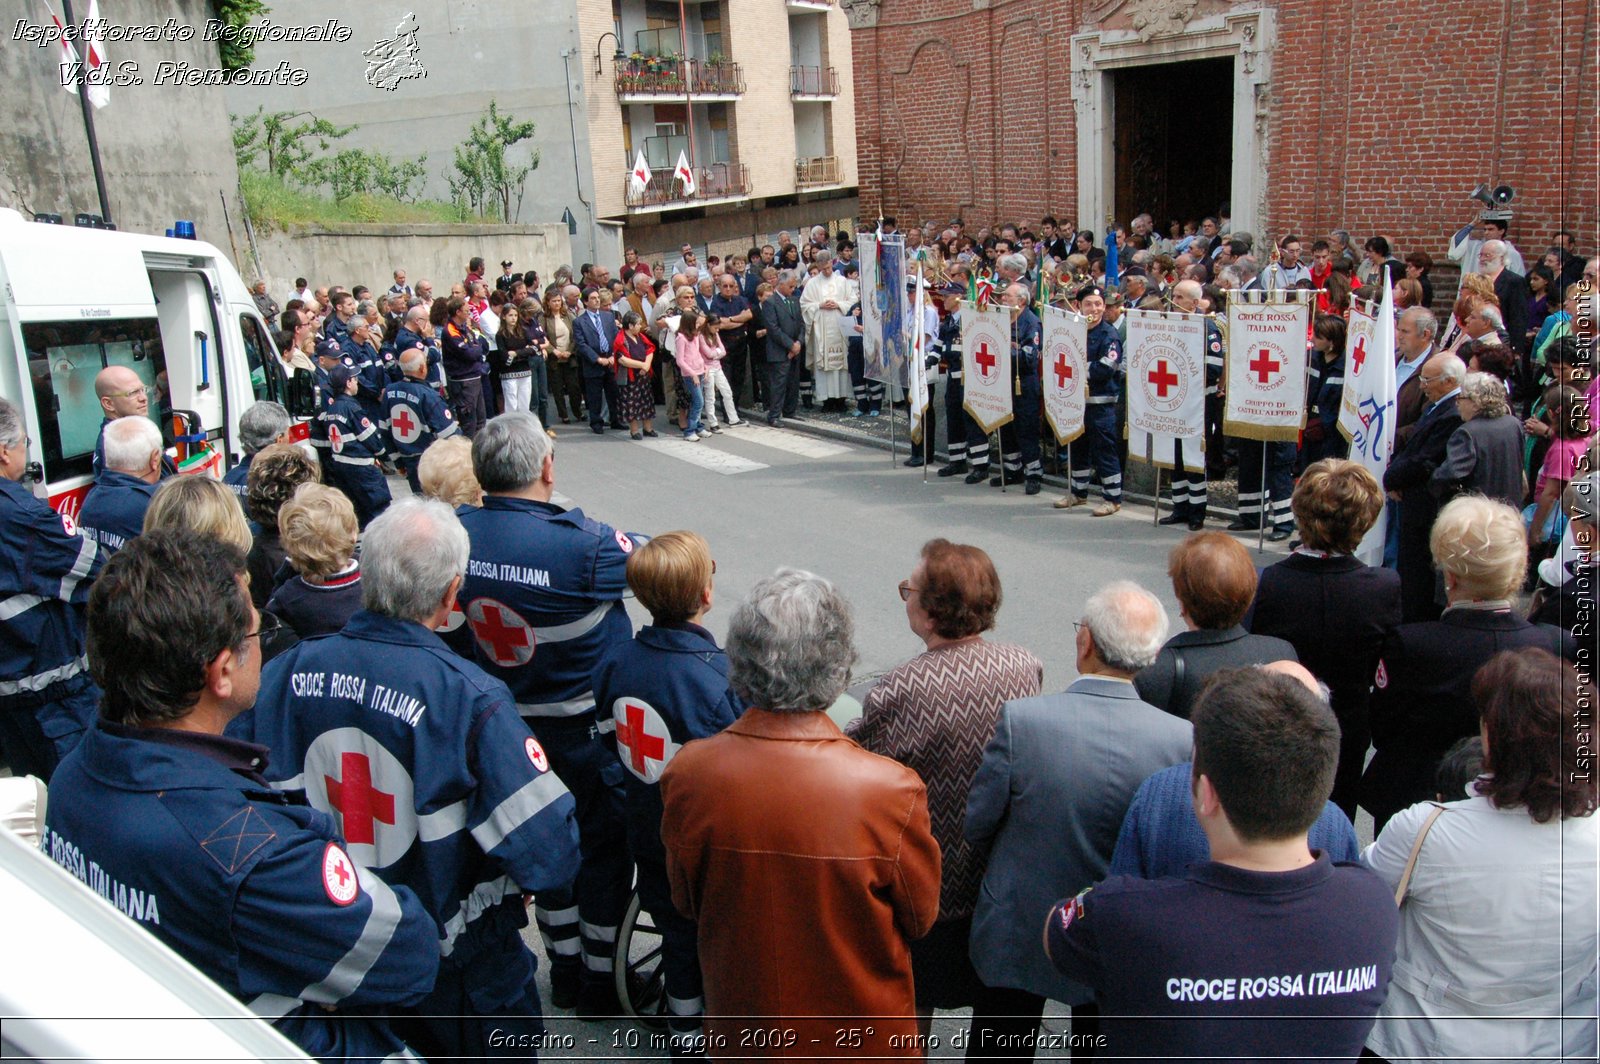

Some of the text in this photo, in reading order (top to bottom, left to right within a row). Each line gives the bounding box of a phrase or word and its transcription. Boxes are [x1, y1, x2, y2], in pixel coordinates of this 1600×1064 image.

[1237, 313, 1298, 322] CROCE ROSSA
[1246, 324, 1287, 333] ITALIANA
[1144, 333, 1173, 343] ROSSA
[1172, 336, 1200, 378] ITALIANA
[1258, 340, 1289, 366] VOLONTARI
[1063, 400, 1082, 412] LOCALE
[1245, 399, 1286, 408] GRUPPO DI
[1135, 418, 1196, 436] CASALBORGONE
[1178, 418, 1186, 426] DI
[99, 530, 125, 550] ITALIANA
[469, 559, 498, 580] ROSSA
[499, 564, 550, 587] ITALIANA
[291, 672, 427, 728] CROCE ROSSA ITALIANA
[51, 830, 88, 886] ROSSA
[89, 861, 160, 925] ITALIANA
[1166, 964, 1377, 1001] CROCE ROSSA ITALIANA
